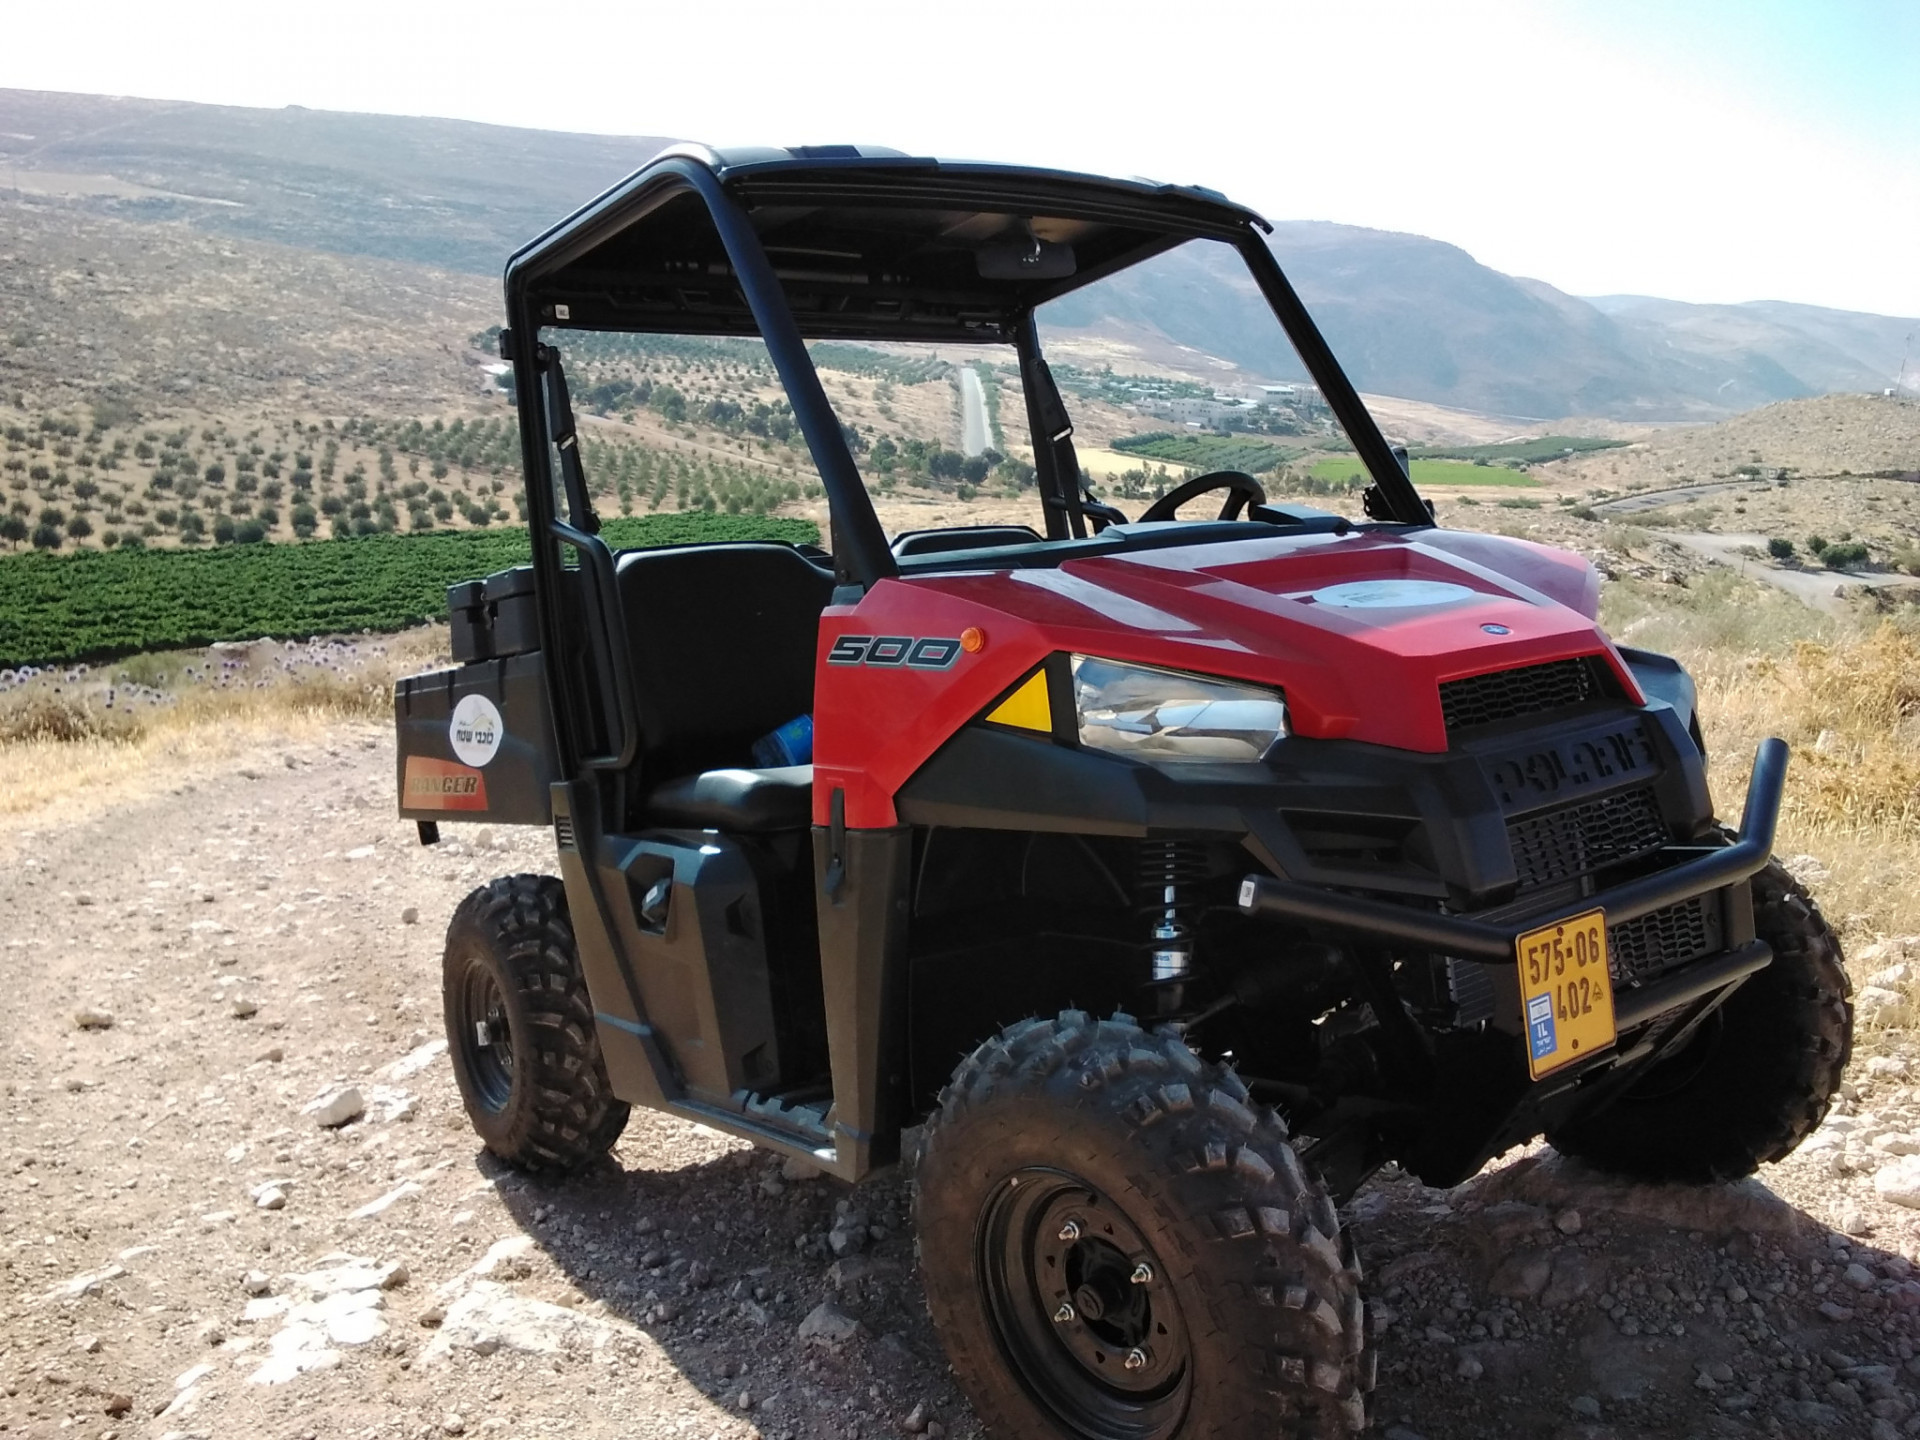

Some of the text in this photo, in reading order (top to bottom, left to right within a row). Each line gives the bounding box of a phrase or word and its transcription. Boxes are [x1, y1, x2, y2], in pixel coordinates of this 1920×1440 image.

[826, 634, 963, 672] 500
[410, 775, 478, 796] RANGER
[1557, 976, 1592, 1023] 402
[1537, 1022, 1548, 1038] IL
